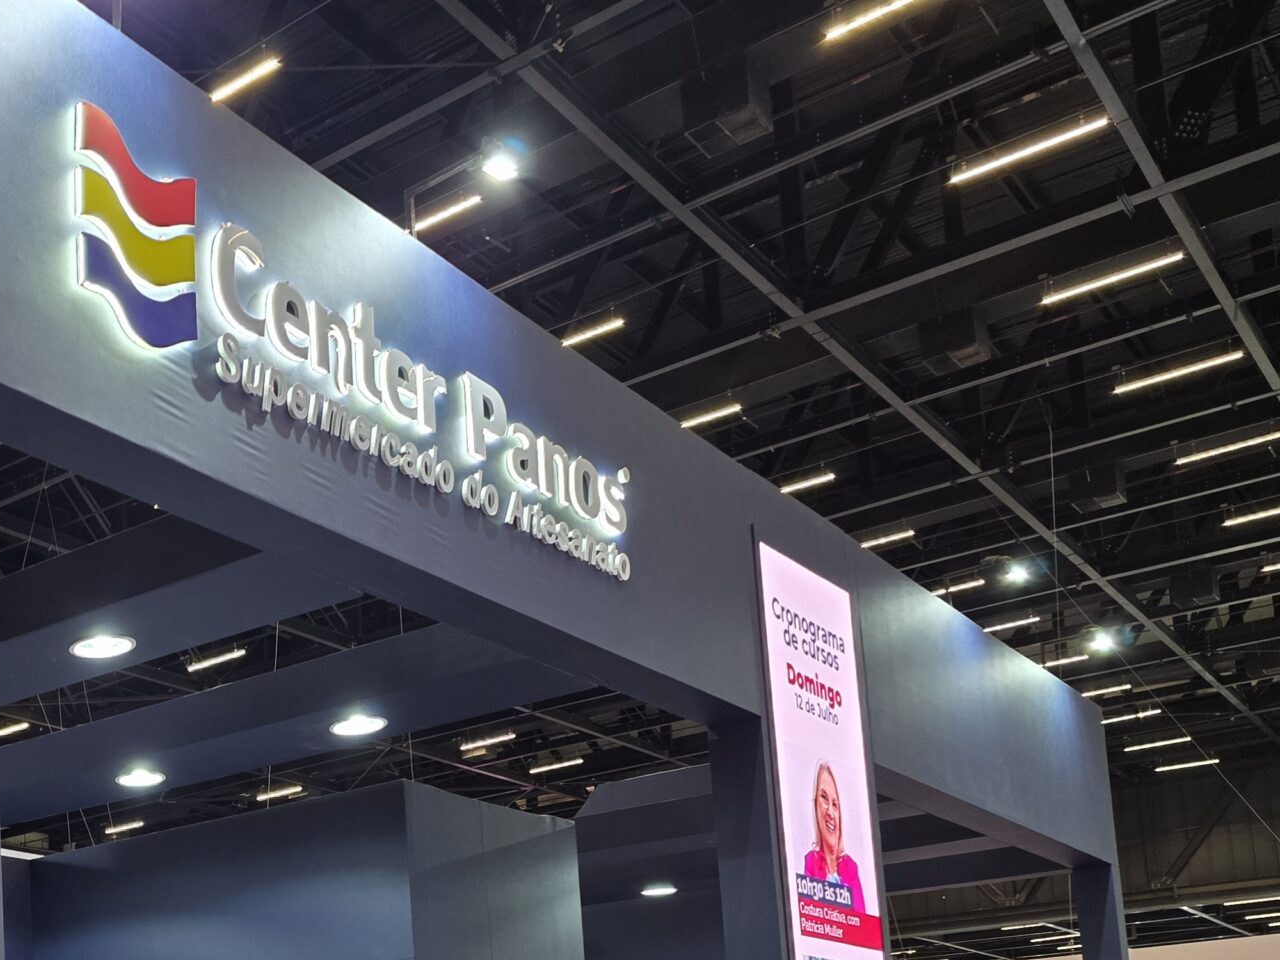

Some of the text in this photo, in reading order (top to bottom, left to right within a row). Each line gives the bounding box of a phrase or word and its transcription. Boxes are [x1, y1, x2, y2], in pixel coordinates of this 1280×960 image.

[211, 223, 628, 535] Center Panos
[216, 332, 631, 581] Supermercado do Artesanato
[772, 597, 846, 654] Cronograma
[783, 625, 840, 671] de cursos
[786, 662, 842, 709] Domingo
[794, 693, 839, 725] 12 de Julho
[796, 877, 852, 905] 10h30 às 12h
[799, 901, 824, 918] Costura
[847, 916, 860, 926] com
